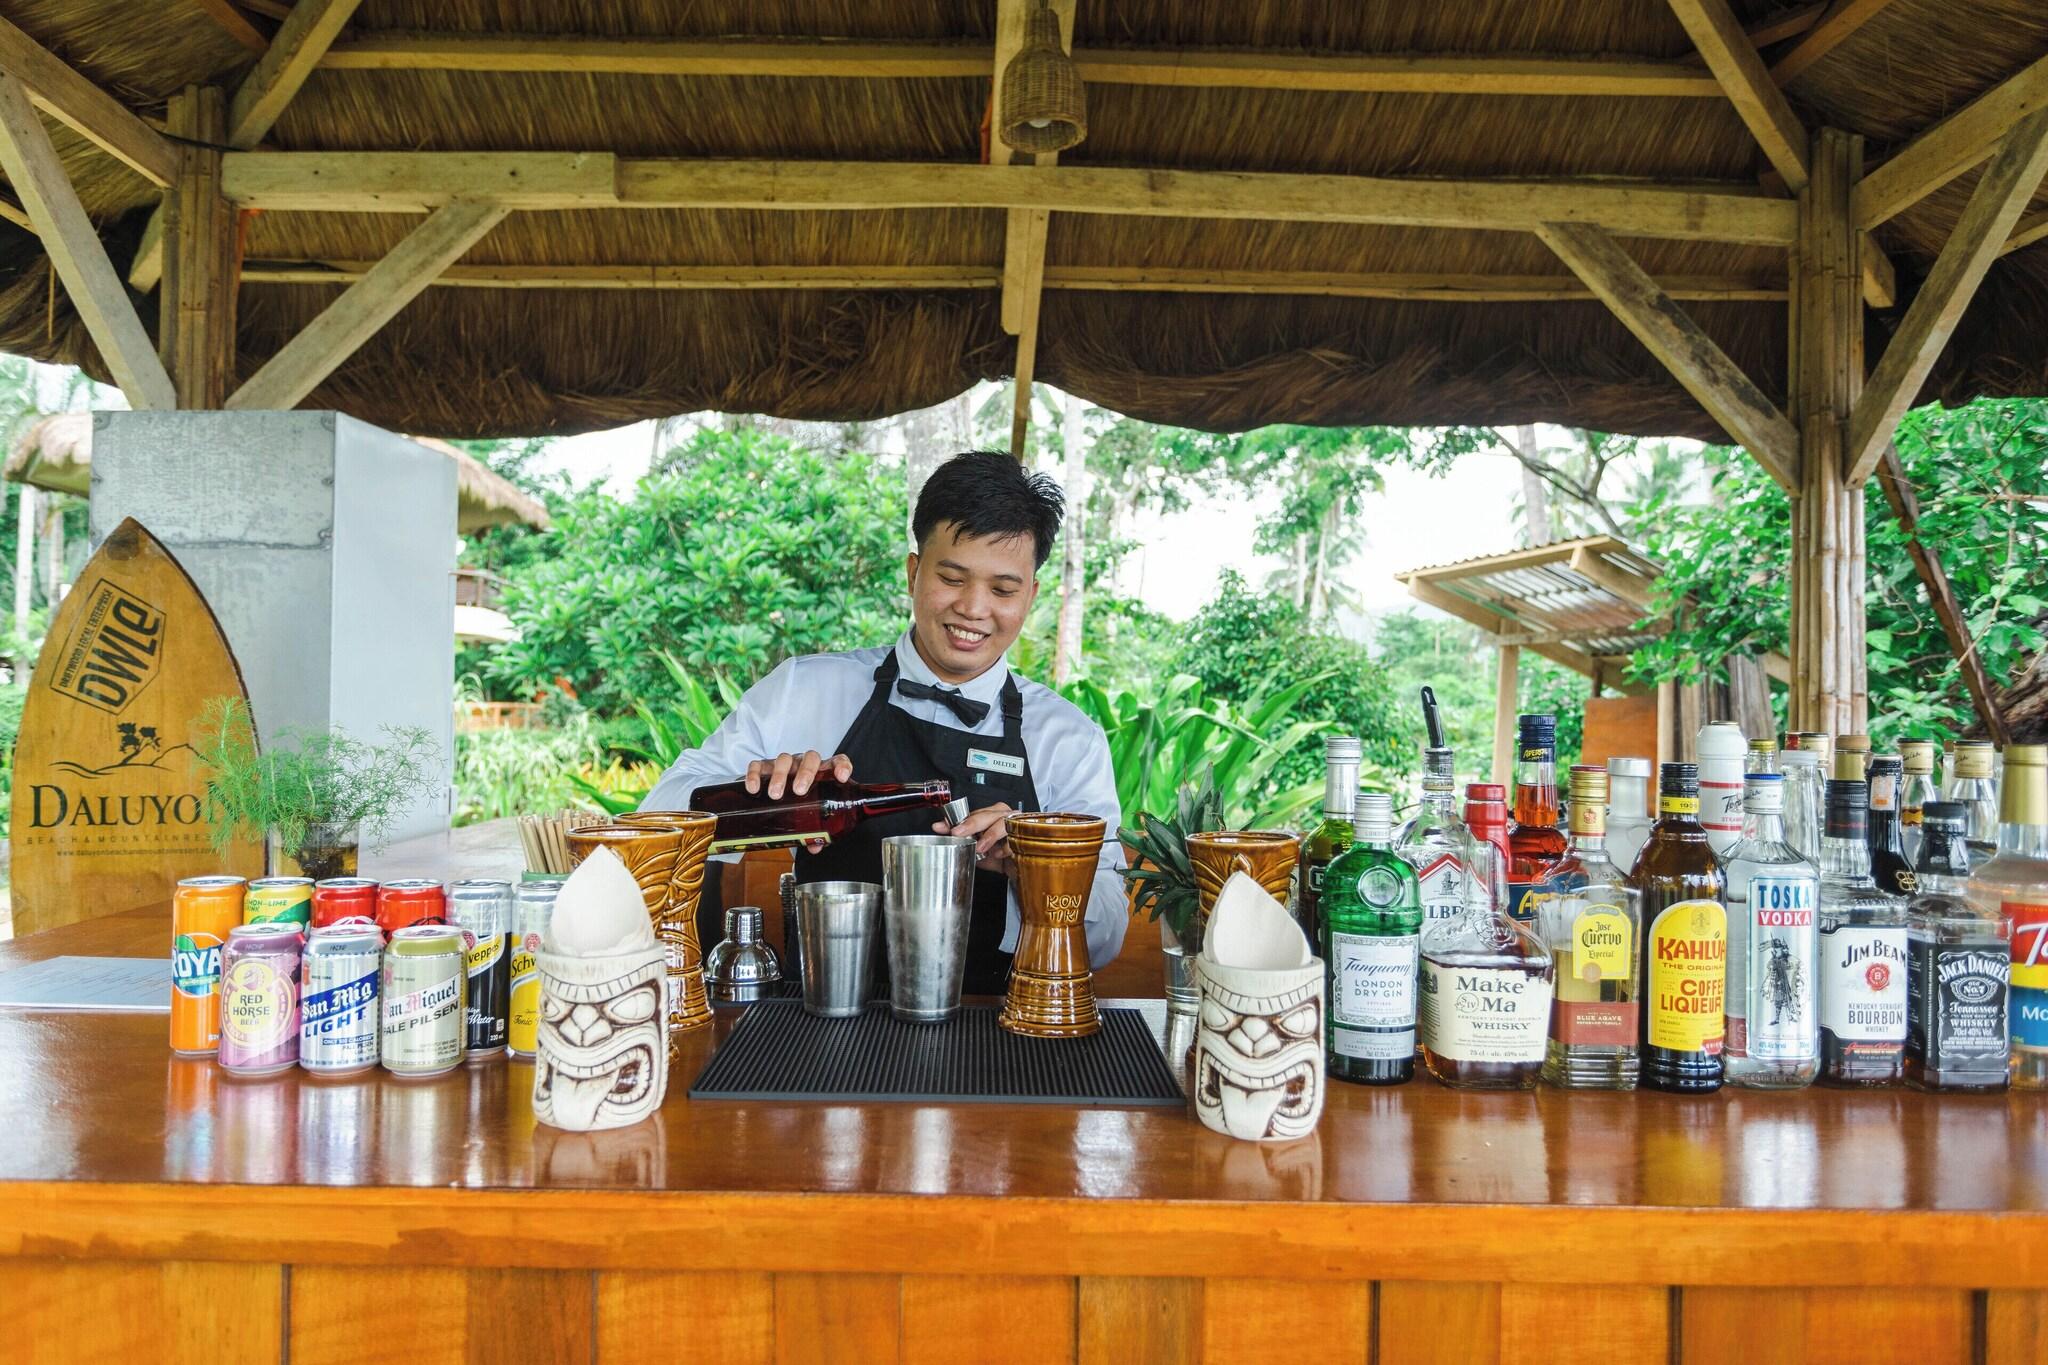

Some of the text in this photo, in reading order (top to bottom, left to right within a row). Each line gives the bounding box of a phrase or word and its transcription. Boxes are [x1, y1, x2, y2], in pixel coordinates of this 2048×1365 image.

[78, 627, 95, 648] LOCAL
[1046, 894, 1082, 909] KON
[1758, 885, 1810, 909] TOSKA
[1047, 909, 1080, 923] TIKI
[1759, 911, 1811, 925] VODKA
[1595, 921, 1611, 932] Jose
[1581, 929, 1622, 948] Cuervo
[1841, 944, 1870, 968] JIM
[1344, 957, 1412, 976] Tanqueray
[1937, 959, 1967, 982] JACK
[1354, 979, 1403, 989] LONDON
[330, 980, 373, 1011] Mig
[404, 980, 457, 1014] Miguel
[1354, 988, 1403, 998] DRY GIN
[240, 994, 263, 1007] RED
[1660, 993, 1722, 1013] LIQUEUR
[232, 1006, 270, 1018] HORSE
[409, 1001, 459, 1029] PILSEN
[1949, 1002, 1998, 1014] Tennessee
[304, 1006, 367, 1038] LIGHT
[468, 1013, 496, 1025] Water
[512, 1014, 533, 1025] Tonic
[1848, 1010, 1903, 1025] BOURBON
[1950, 1019, 1998, 1027] WHISKEY
[1471, 1021, 1531, 1031] WHISKY
[1968, 1028, 1982, 1036] 40%
